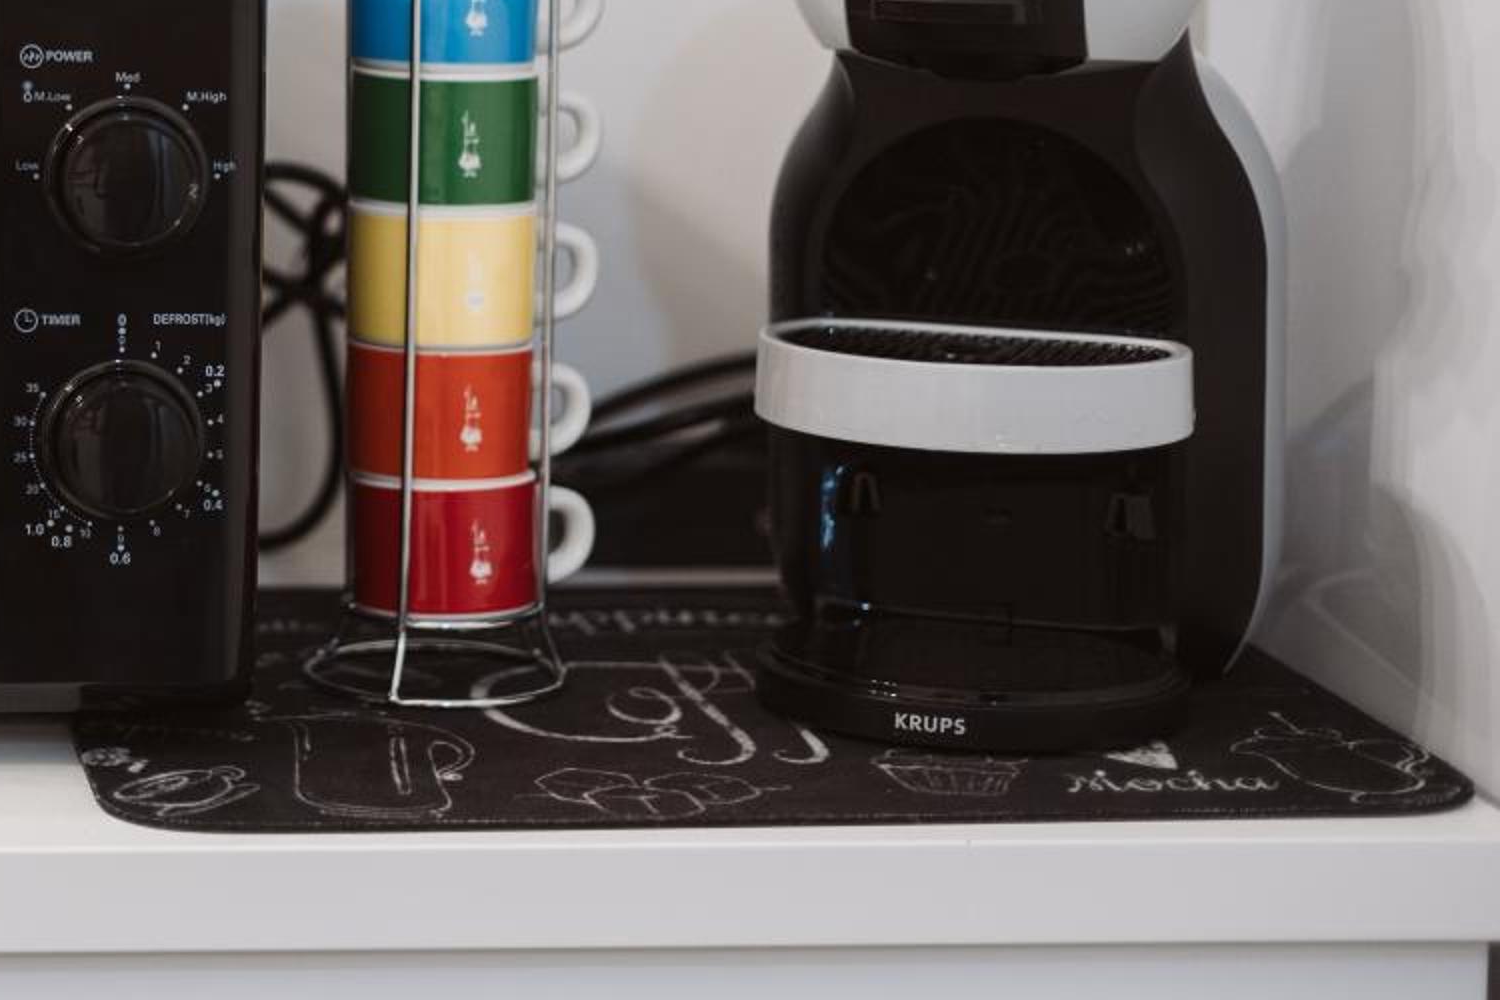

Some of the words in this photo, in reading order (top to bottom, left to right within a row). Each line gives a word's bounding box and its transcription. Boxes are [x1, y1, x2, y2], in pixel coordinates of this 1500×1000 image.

[45, 49, 93, 63] POWER
[115, 71, 141, 84] Med
[186, 90, 228, 105] M.High
[15, 160, 39, 172] Low
[213, 160, 237, 173] High
[41, 314, 82, 326] TIMER
[204, 365, 225, 377] 0.2
[203, 499, 224, 511] 0.4
[24, 523, 45, 535] 1.0
[50, 535, 73, 548] 0.8
[109, 552, 132, 565] 0.6
[894, 711, 966, 736] KRUPS
